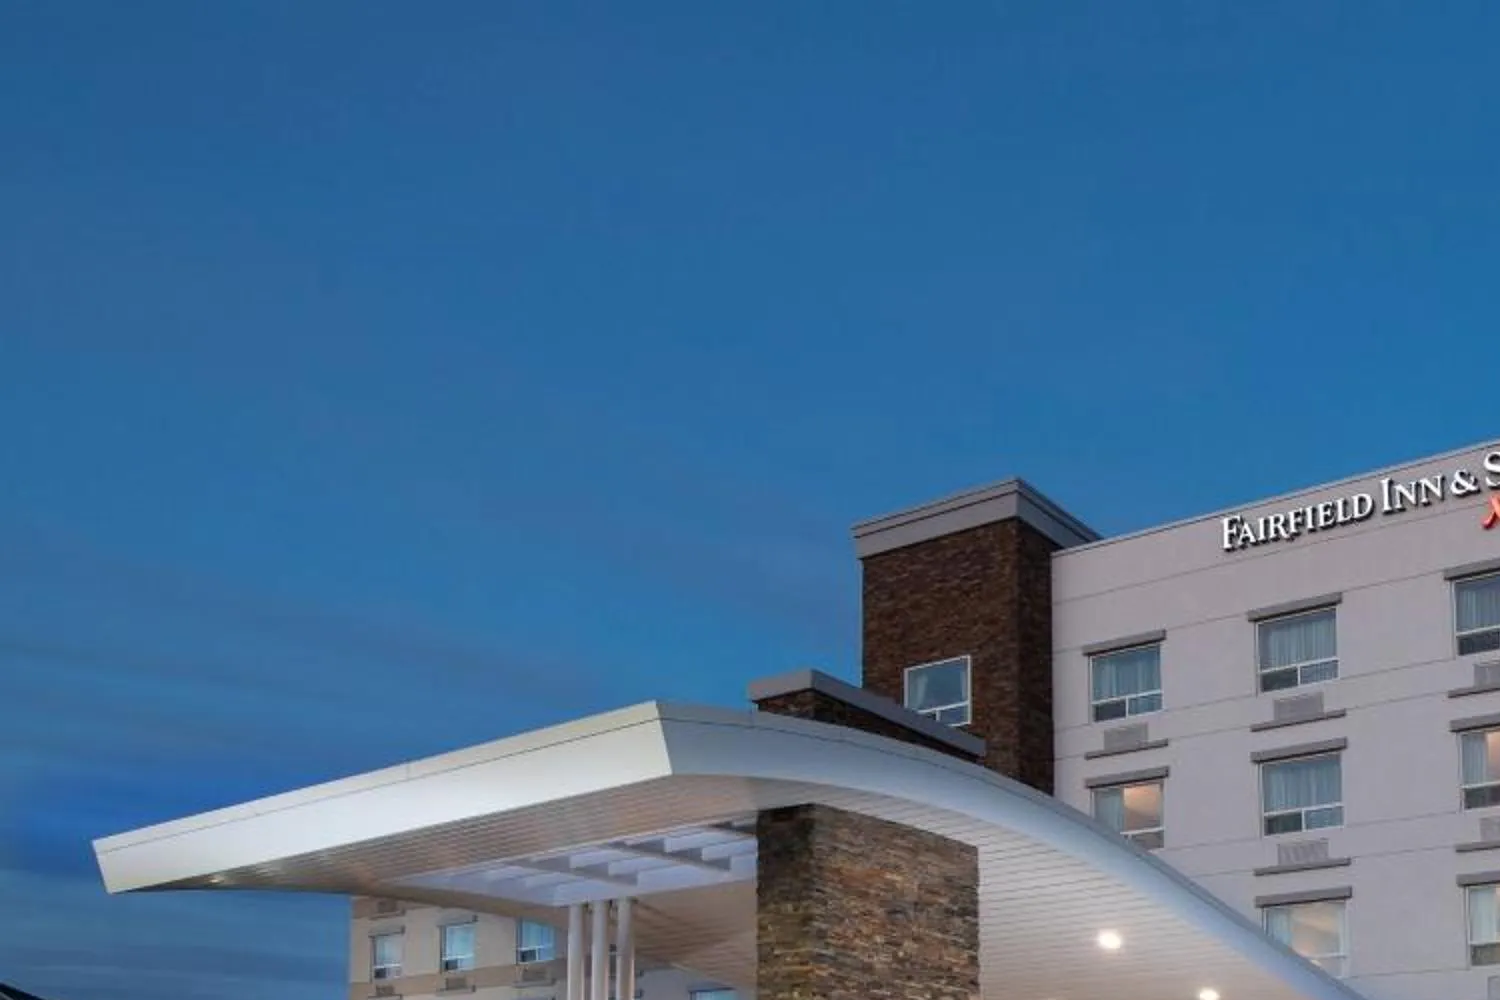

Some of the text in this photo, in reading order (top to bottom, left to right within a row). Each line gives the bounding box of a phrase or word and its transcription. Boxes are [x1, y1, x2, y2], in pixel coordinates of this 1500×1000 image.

[1221, 493, 1374, 551] FAIRFIELD
[1380, 474, 1445, 515] INN
[1450, 468, 1480, 497] &
